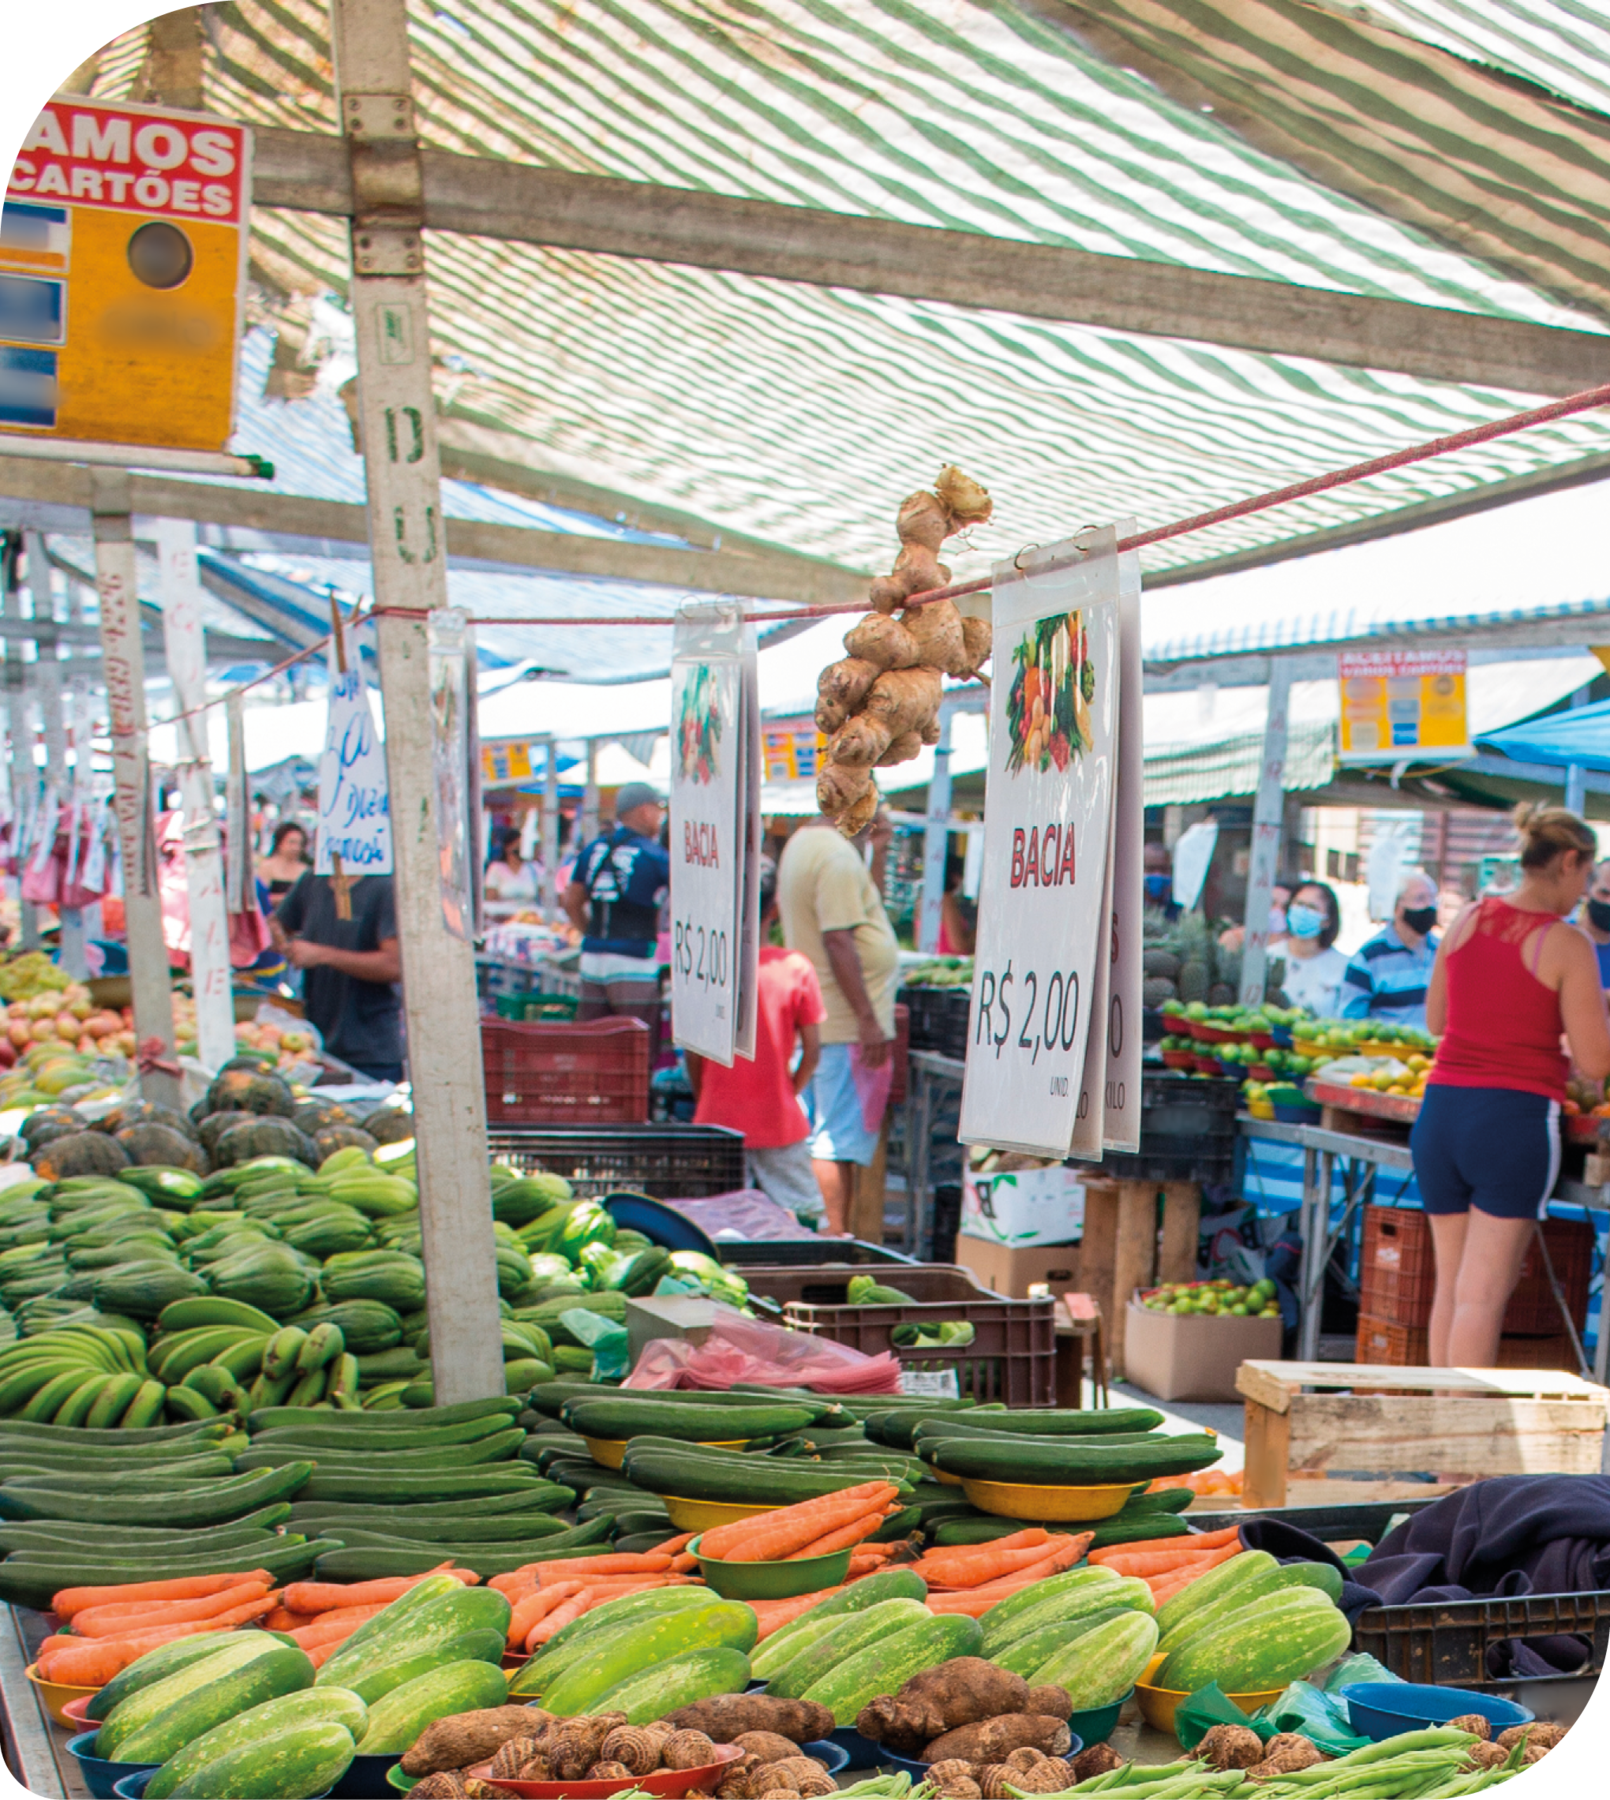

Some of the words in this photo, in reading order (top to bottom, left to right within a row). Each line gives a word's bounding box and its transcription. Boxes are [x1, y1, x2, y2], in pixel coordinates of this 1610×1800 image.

[19, 109, 236, 177] AMOS
[7, 157, 233, 215] CARTÕES
[684, 820, 719, 869] BACIA
[1010, 822, 1076, 889] BACIA
[675, 914, 692, 985] R$
[696, 926, 727, 993] 2,00
[976, 959, 1014, 1060] R$
[1018, 971, 1080, 1066] 2,00
